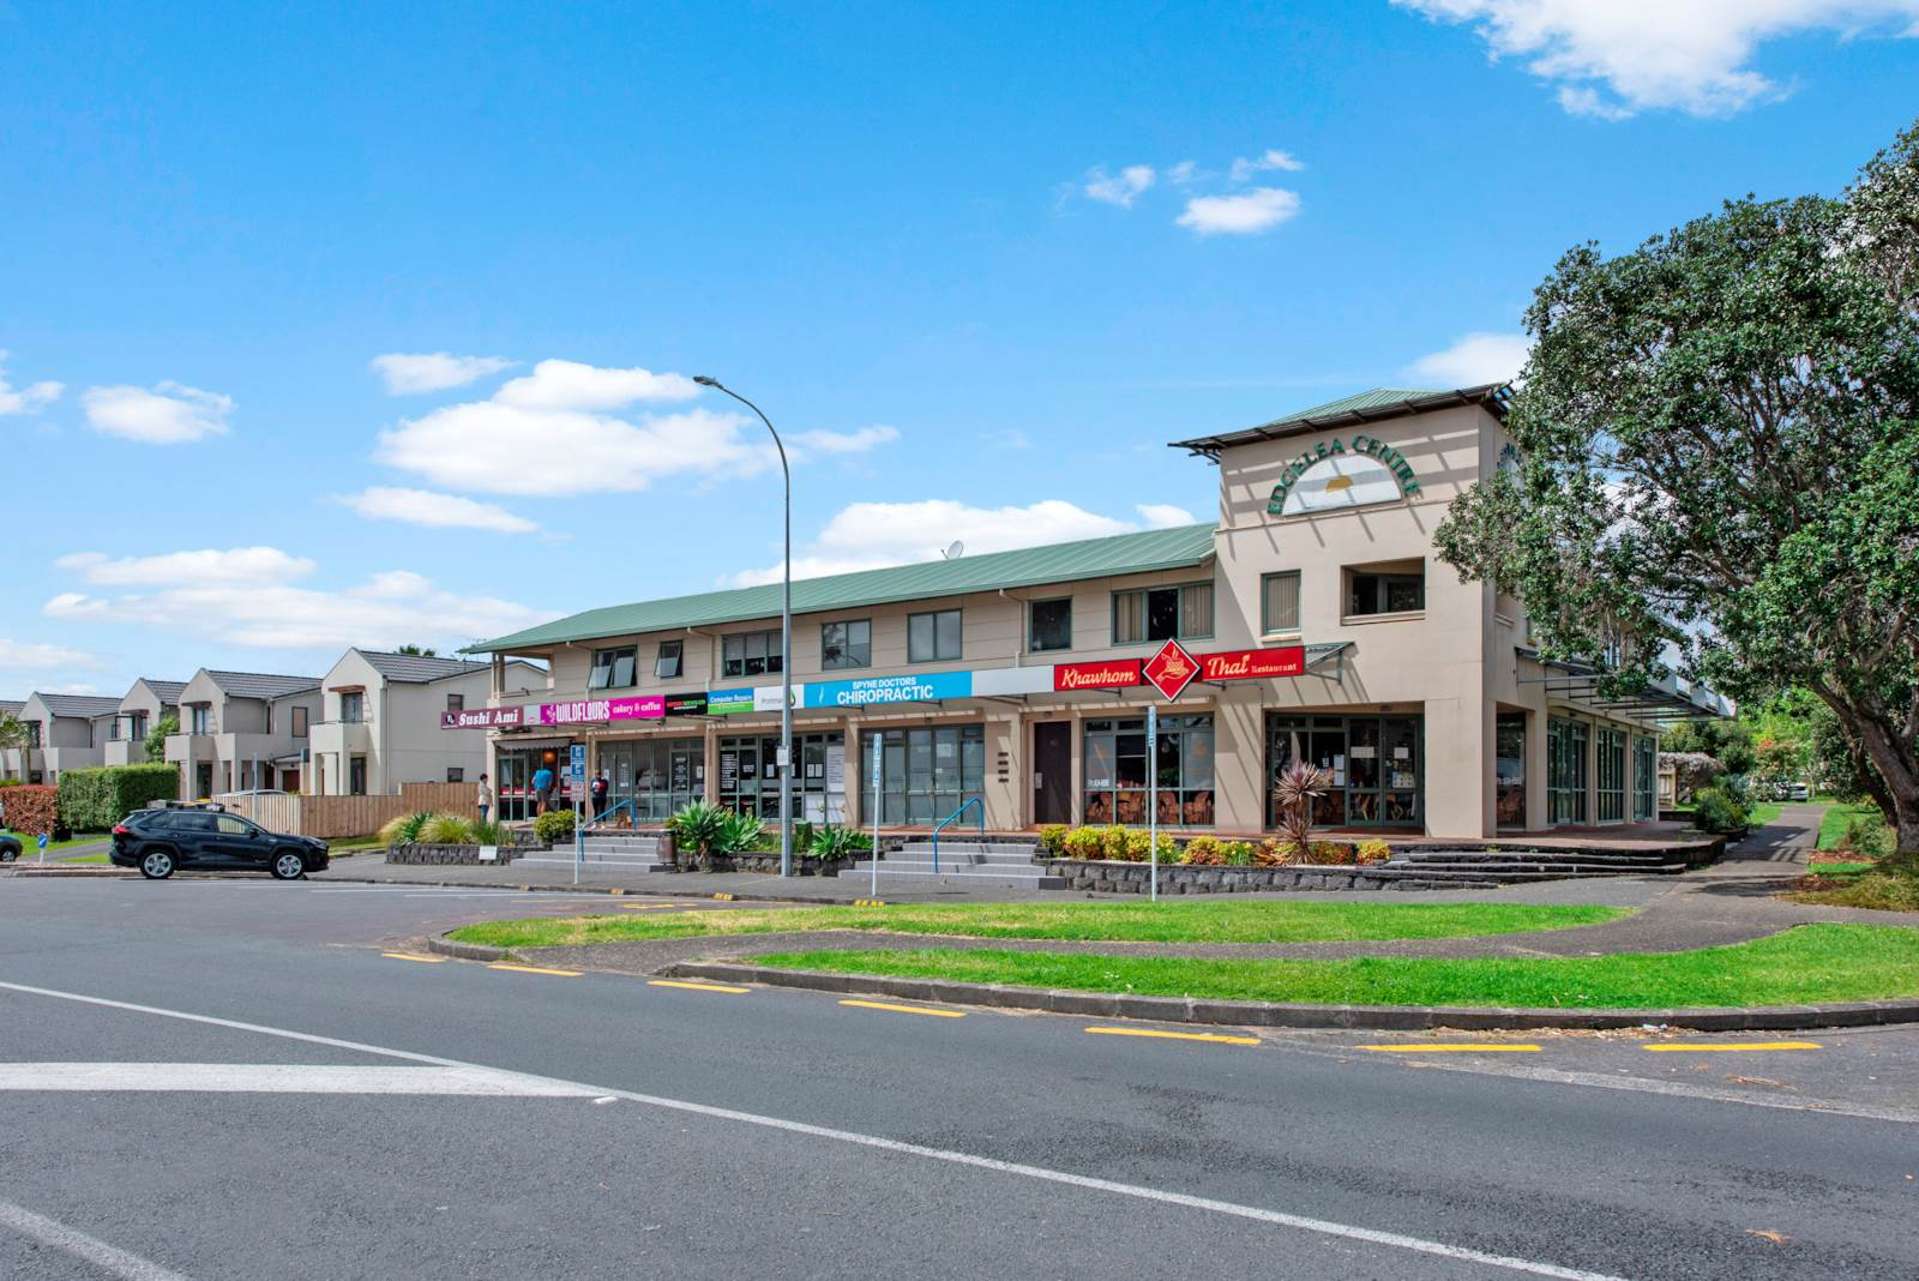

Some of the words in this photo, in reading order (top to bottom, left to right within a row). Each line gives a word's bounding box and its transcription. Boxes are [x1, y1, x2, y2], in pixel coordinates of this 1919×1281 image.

[1267, 436, 1346, 515] EDGELEA
[1061, 667, 1136, 688] Khawhom
[1207, 653, 1251, 677] Thai
[1251, 663, 1297, 673] Restaurant
[852, 679, 878, 690] SPYNE
[878, 676, 917, 687] DOCTORS
[837, 685, 934, 705] CHIROPRACTIC
[556, 701, 610, 722] WILDFLOURS
[640, 701, 661, 712] coffee
[459, 711, 490, 727] Sushi
[494, 708, 519, 724] Ami
